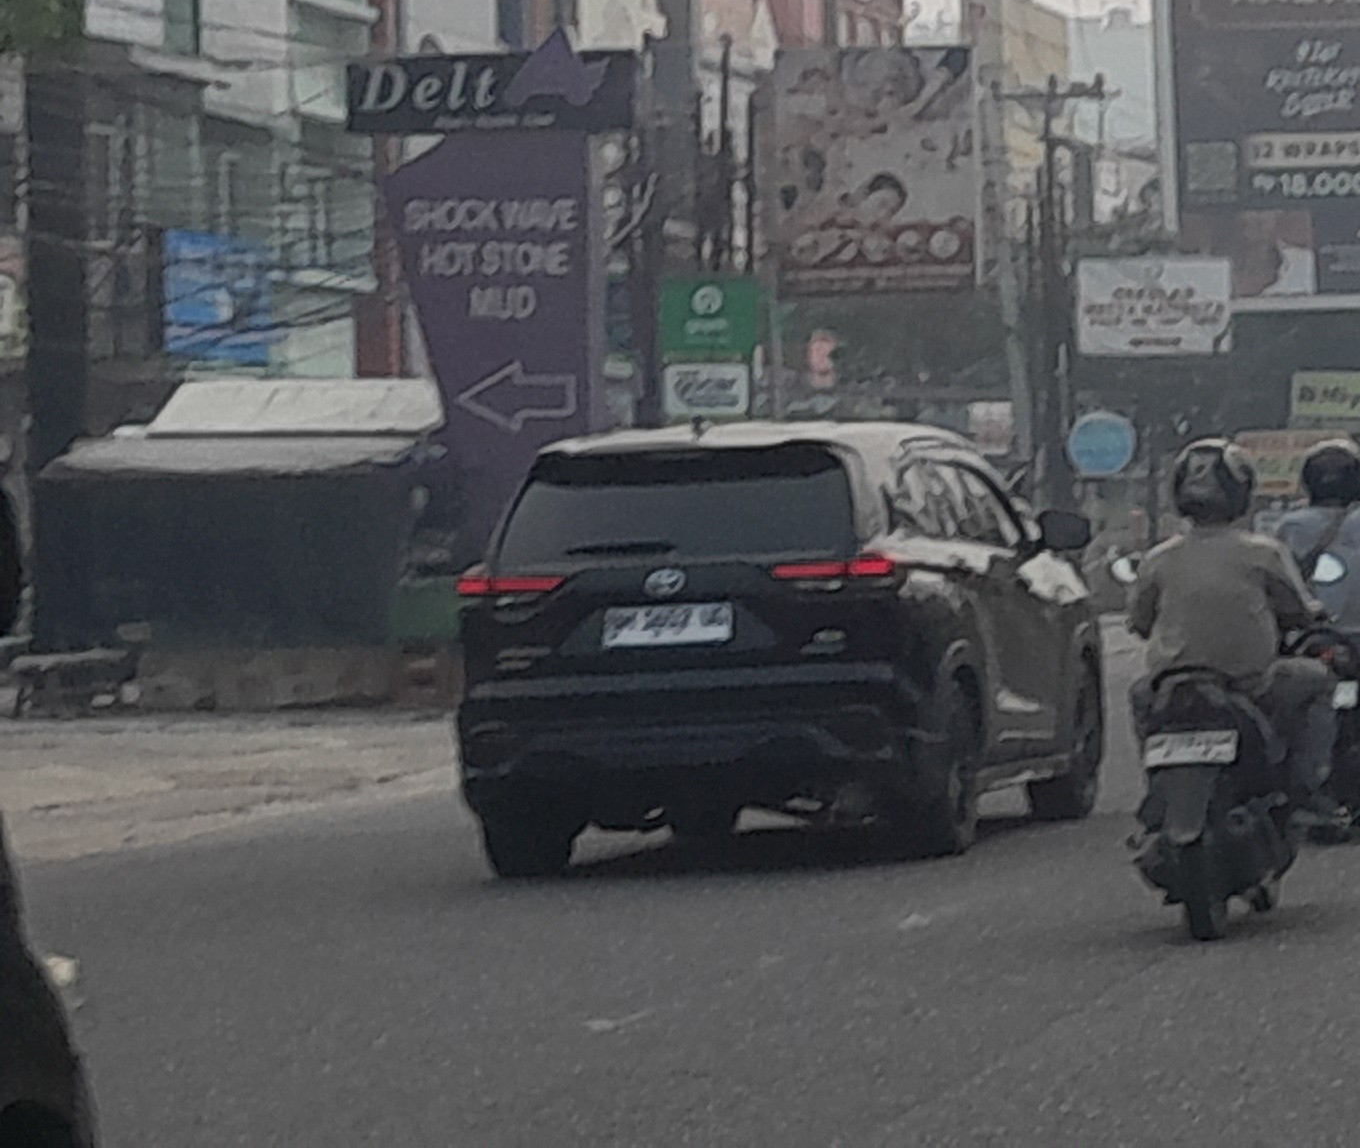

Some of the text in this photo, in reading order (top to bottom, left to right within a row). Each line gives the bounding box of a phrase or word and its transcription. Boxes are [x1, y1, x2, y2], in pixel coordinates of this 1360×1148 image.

[404, 198, 578, 231] SHOCK WAVE
[421, 240, 570, 277] HOT STONE
[469, 285, 538, 320] MUD
